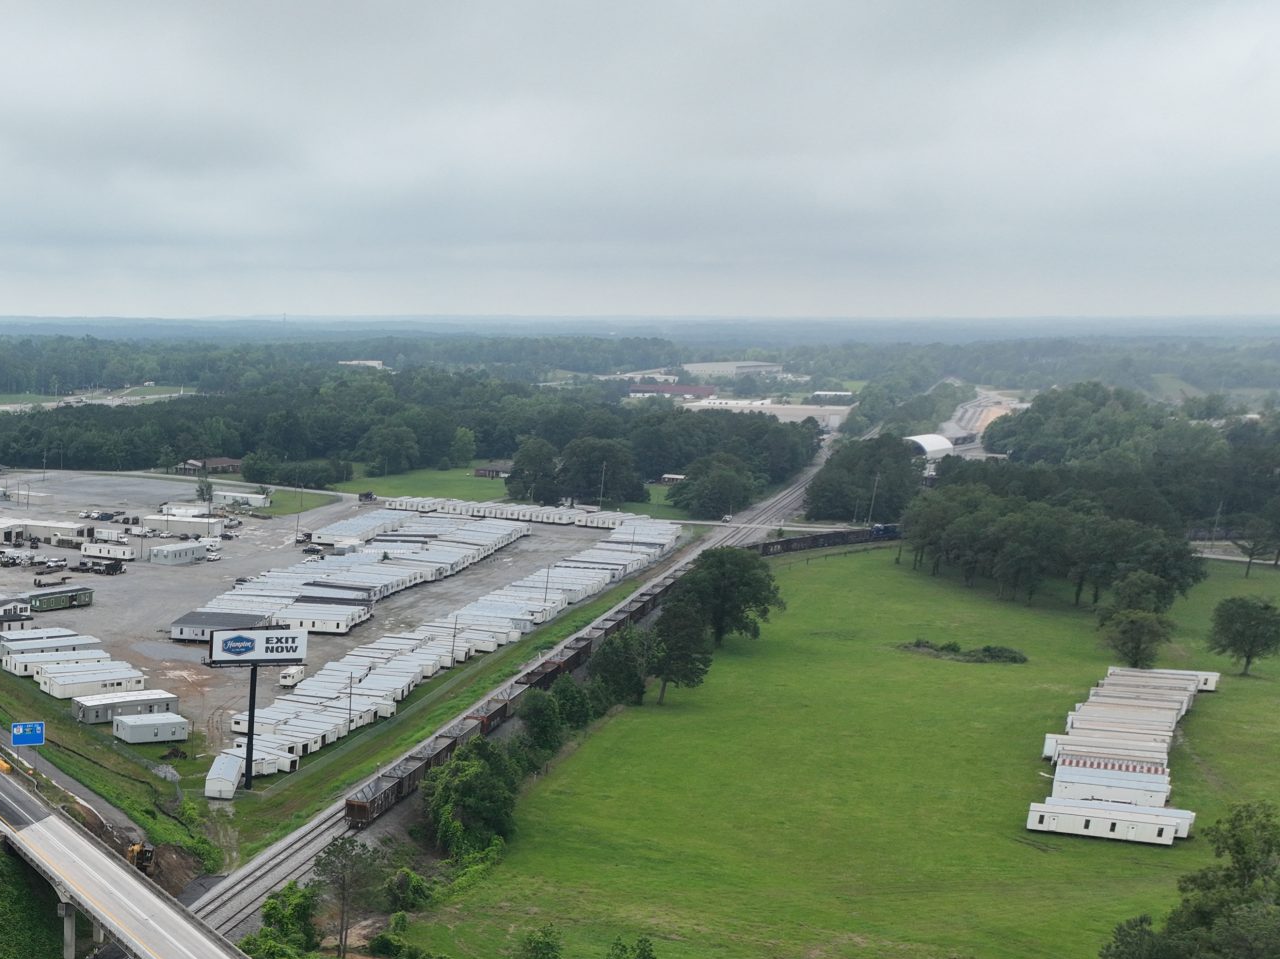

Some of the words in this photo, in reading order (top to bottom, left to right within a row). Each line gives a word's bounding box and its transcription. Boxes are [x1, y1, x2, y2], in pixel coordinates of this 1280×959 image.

[224, 640, 255, 649] Hampton
[265, 636, 299, 645] EXIT
[264, 645, 299, 654] NOW
